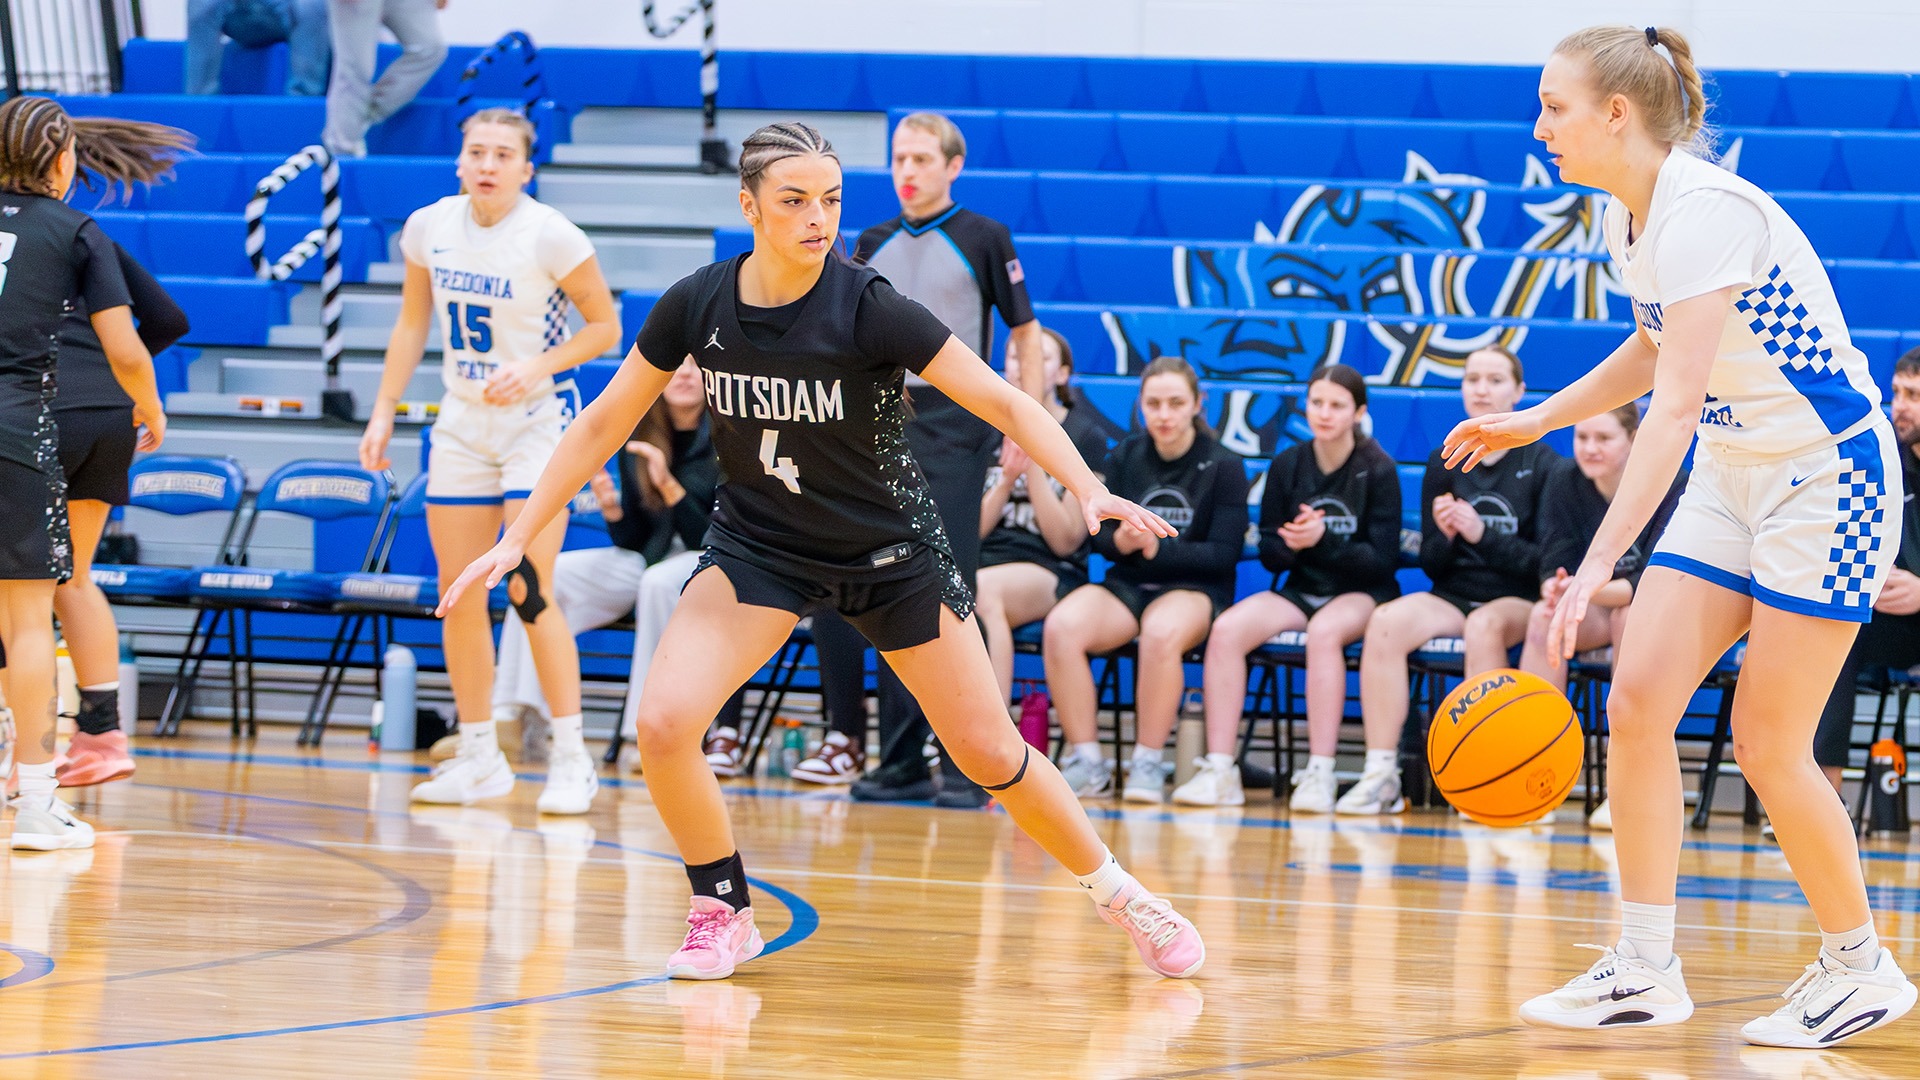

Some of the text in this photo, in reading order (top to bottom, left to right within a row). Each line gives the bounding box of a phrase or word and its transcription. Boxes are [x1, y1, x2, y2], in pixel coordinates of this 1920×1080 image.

[434, 267, 513, 298] FREDONIA
[447, 301, 493, 353] 15
[701, 367, 844, 423] POTSDAM
[758, 429, 802, 494] 4
[898, 547, 907, 557] M
[1448, 675, 1516, 725] NCAA
